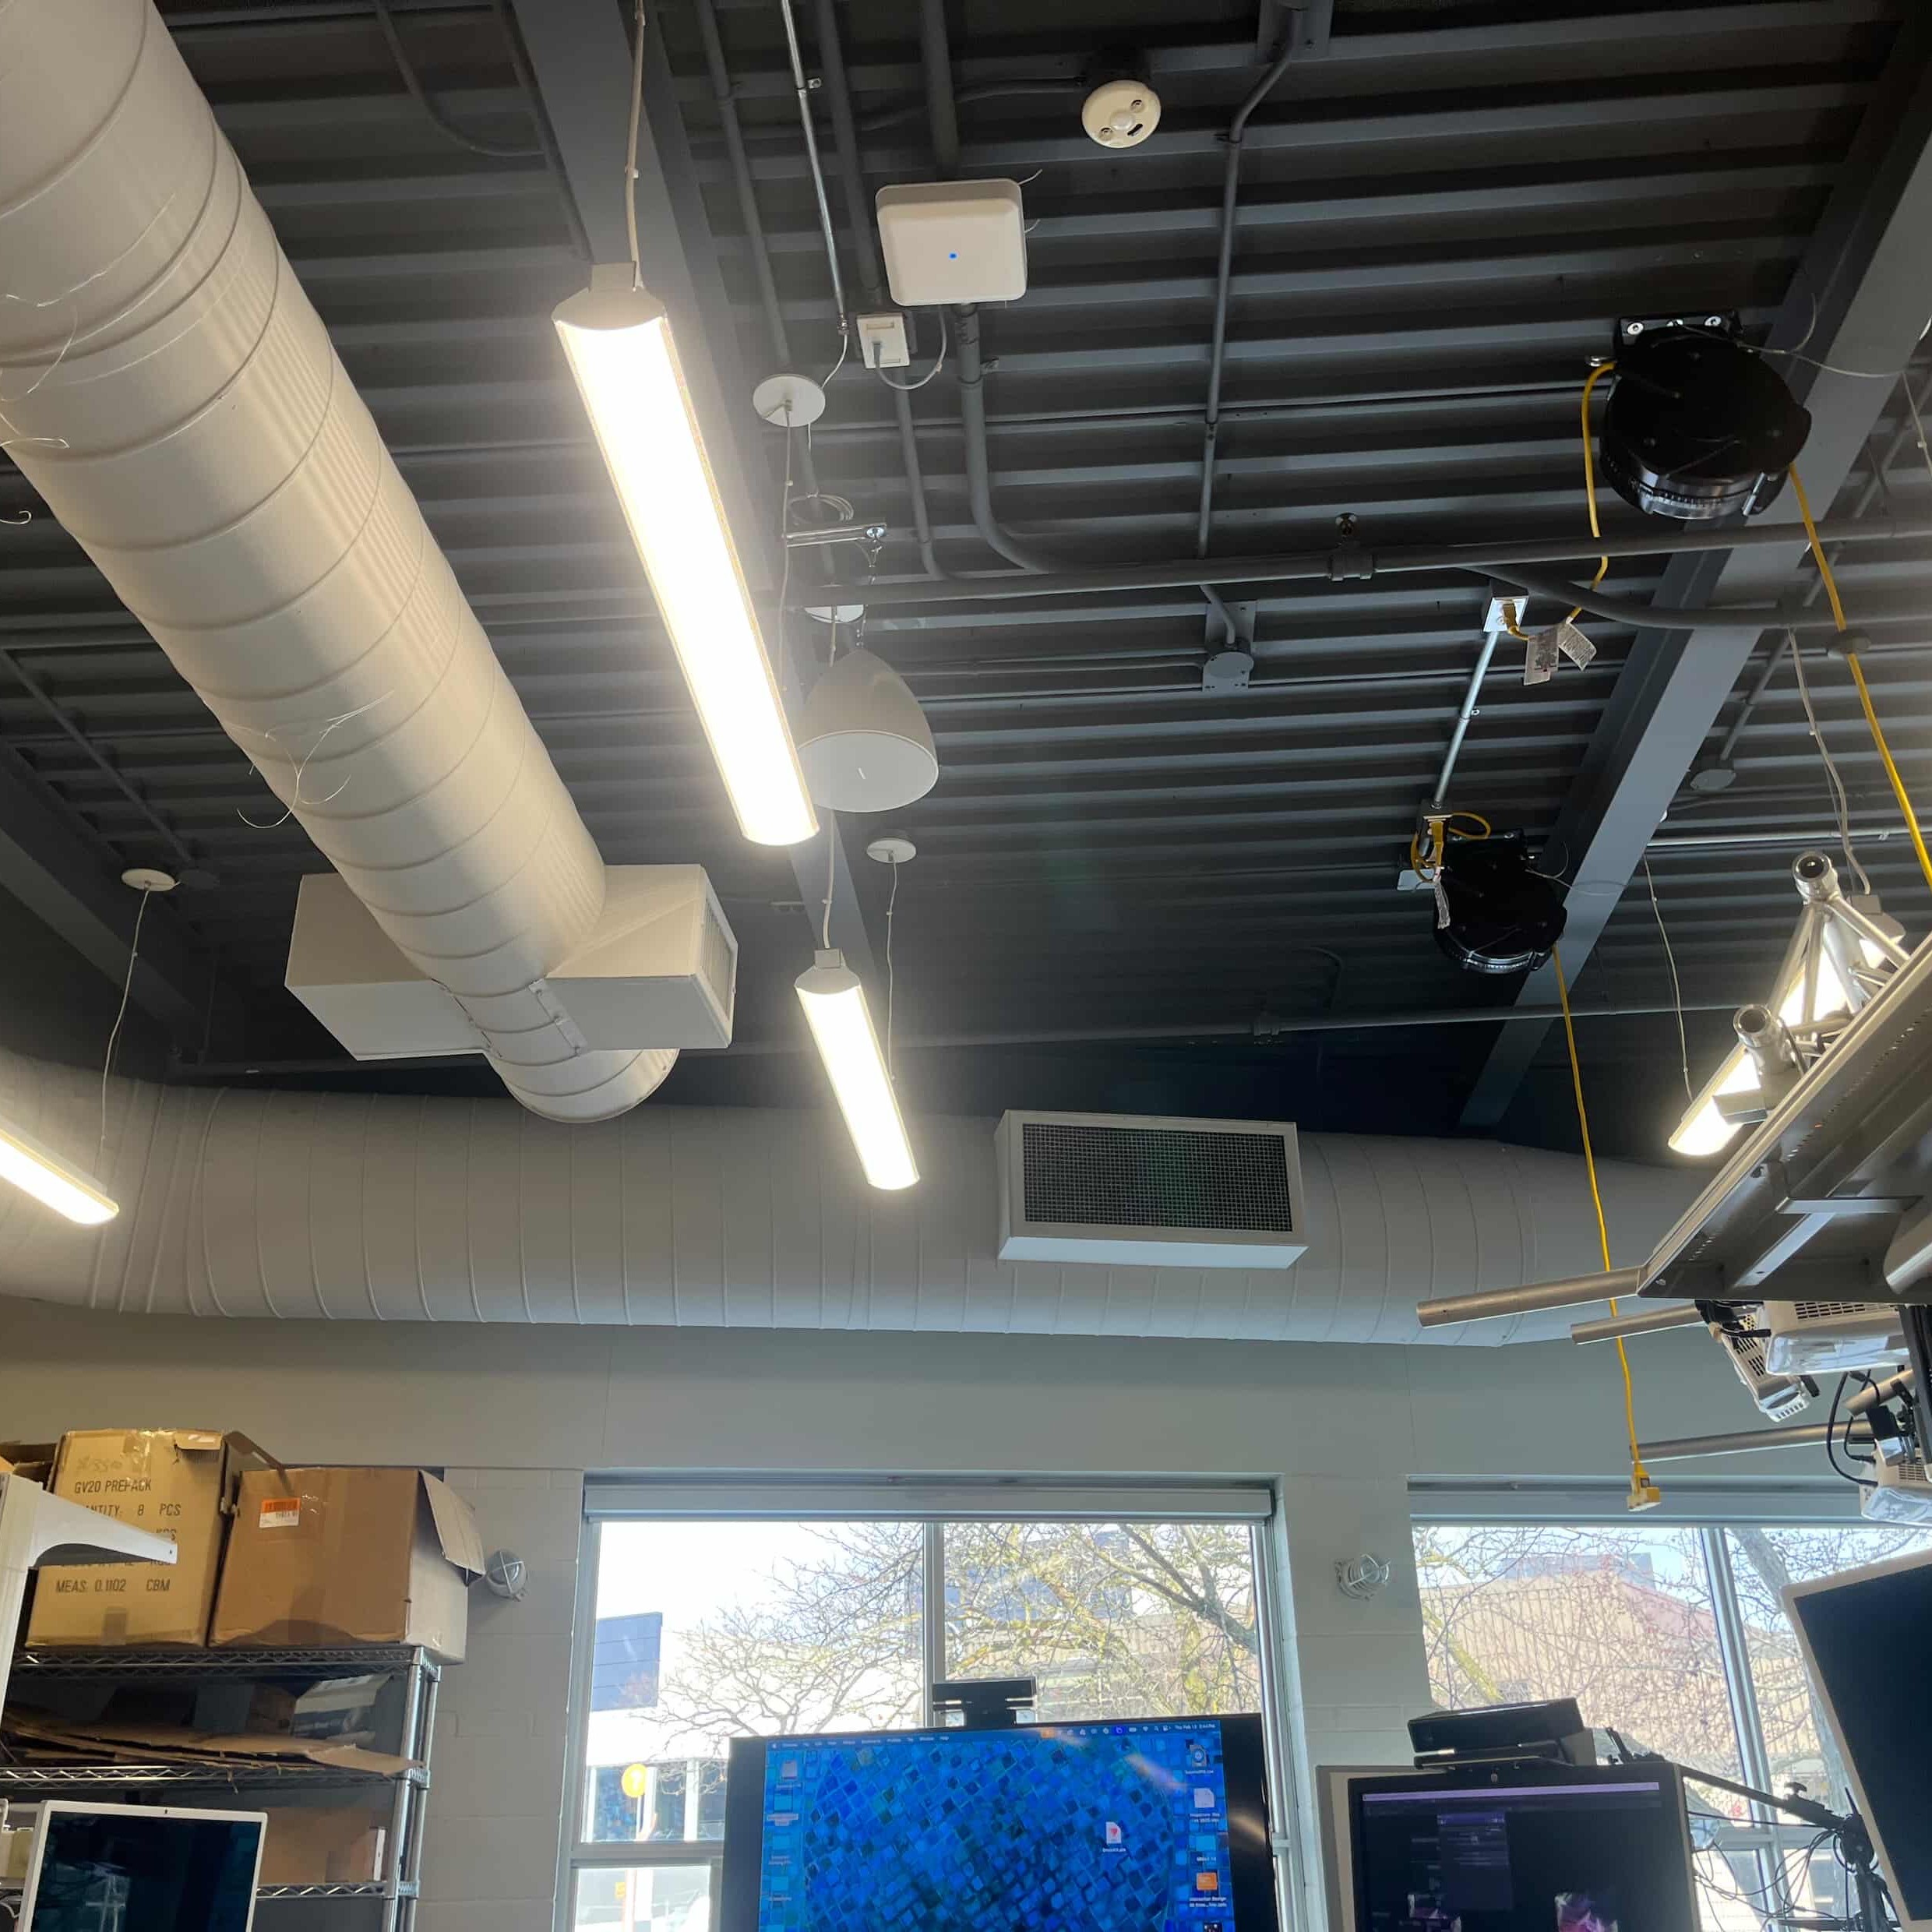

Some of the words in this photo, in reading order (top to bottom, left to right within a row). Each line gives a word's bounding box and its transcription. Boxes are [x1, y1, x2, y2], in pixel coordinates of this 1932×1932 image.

[75, 1480, 101, 1493] GV20
[138, 1504, 144, 1516] 8
[160, 1504, 182, 1516] PCS
[146, 1578, 171, 1592] CBM
